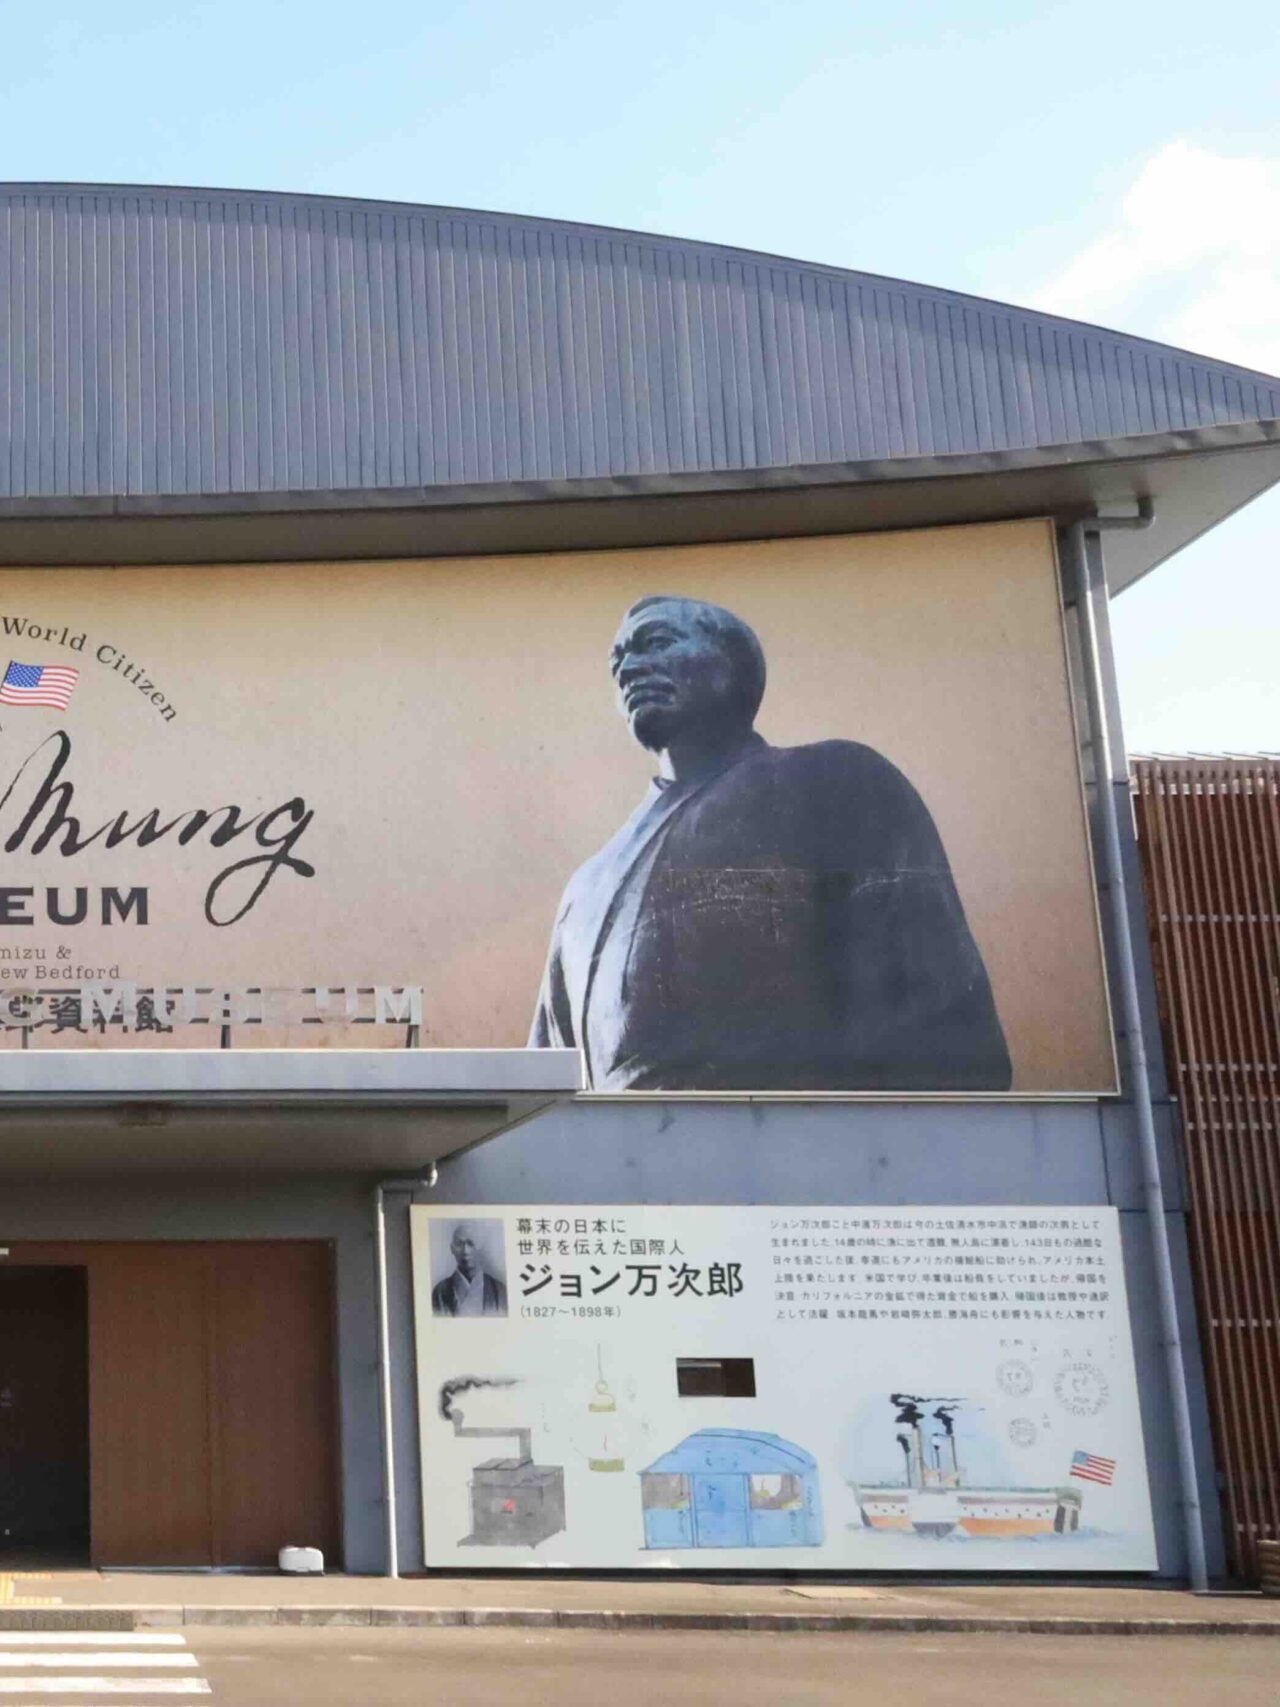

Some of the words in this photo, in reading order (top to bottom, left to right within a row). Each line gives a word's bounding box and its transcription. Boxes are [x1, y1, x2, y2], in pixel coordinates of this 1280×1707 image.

[1, 616, 87, 651] World
[96, 644, 178, 723] Citizen
[56, 945, 72, 960] &
[35, 964, 121, 980] Bedford
[516, 1218, 627, 1234] 幕末の日本に
[517, 1238, 685, 1256] 世界を伝えた国際人
[519, 1262, 744, 1298] ジョン万次郎
